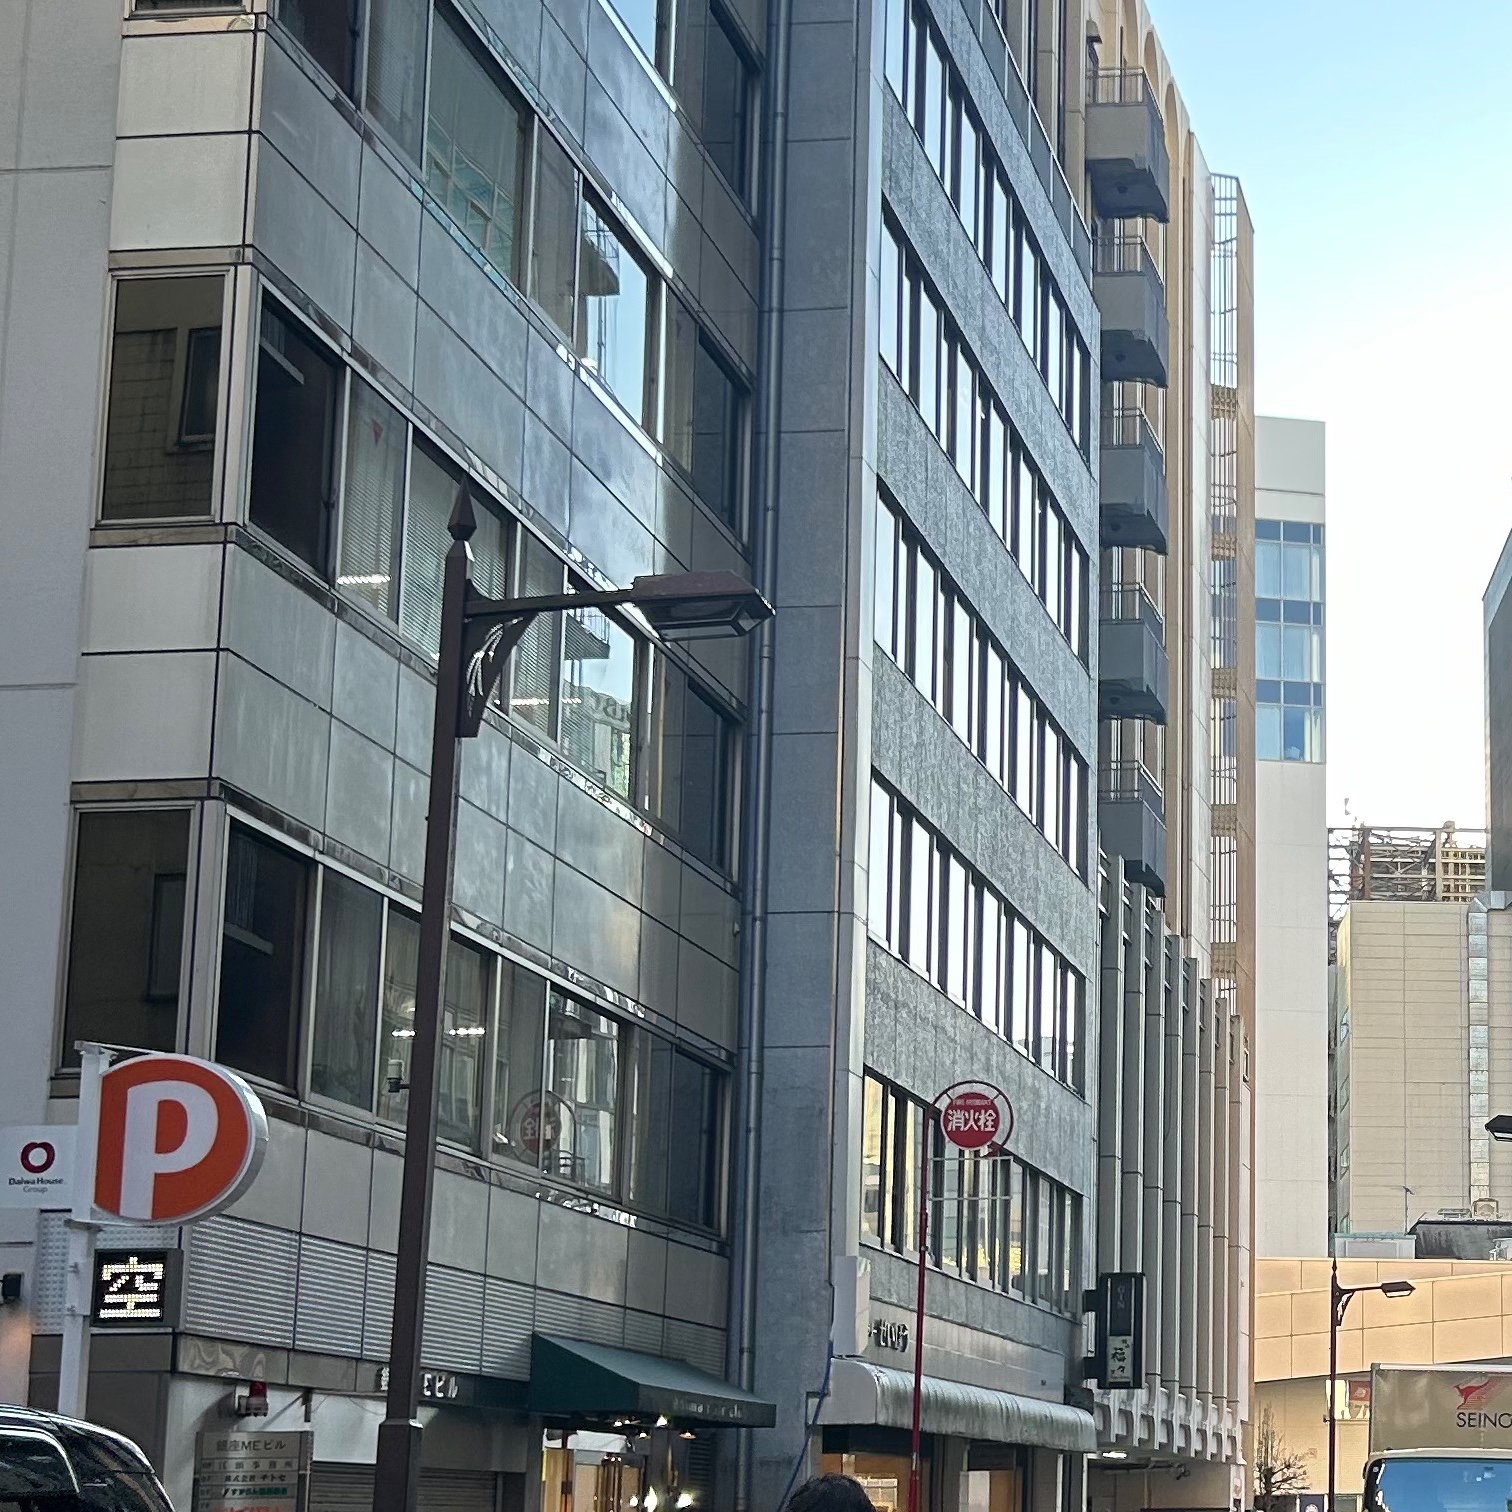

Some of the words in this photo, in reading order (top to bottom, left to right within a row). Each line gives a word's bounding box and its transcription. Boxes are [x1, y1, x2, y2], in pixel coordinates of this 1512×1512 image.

[946, 1109, 997, 1132] 消火栓
[119, 1080, 219, 1220] P
[37, 1177, 63, 1185] House
[99, 1256, 164, 1319] 空
